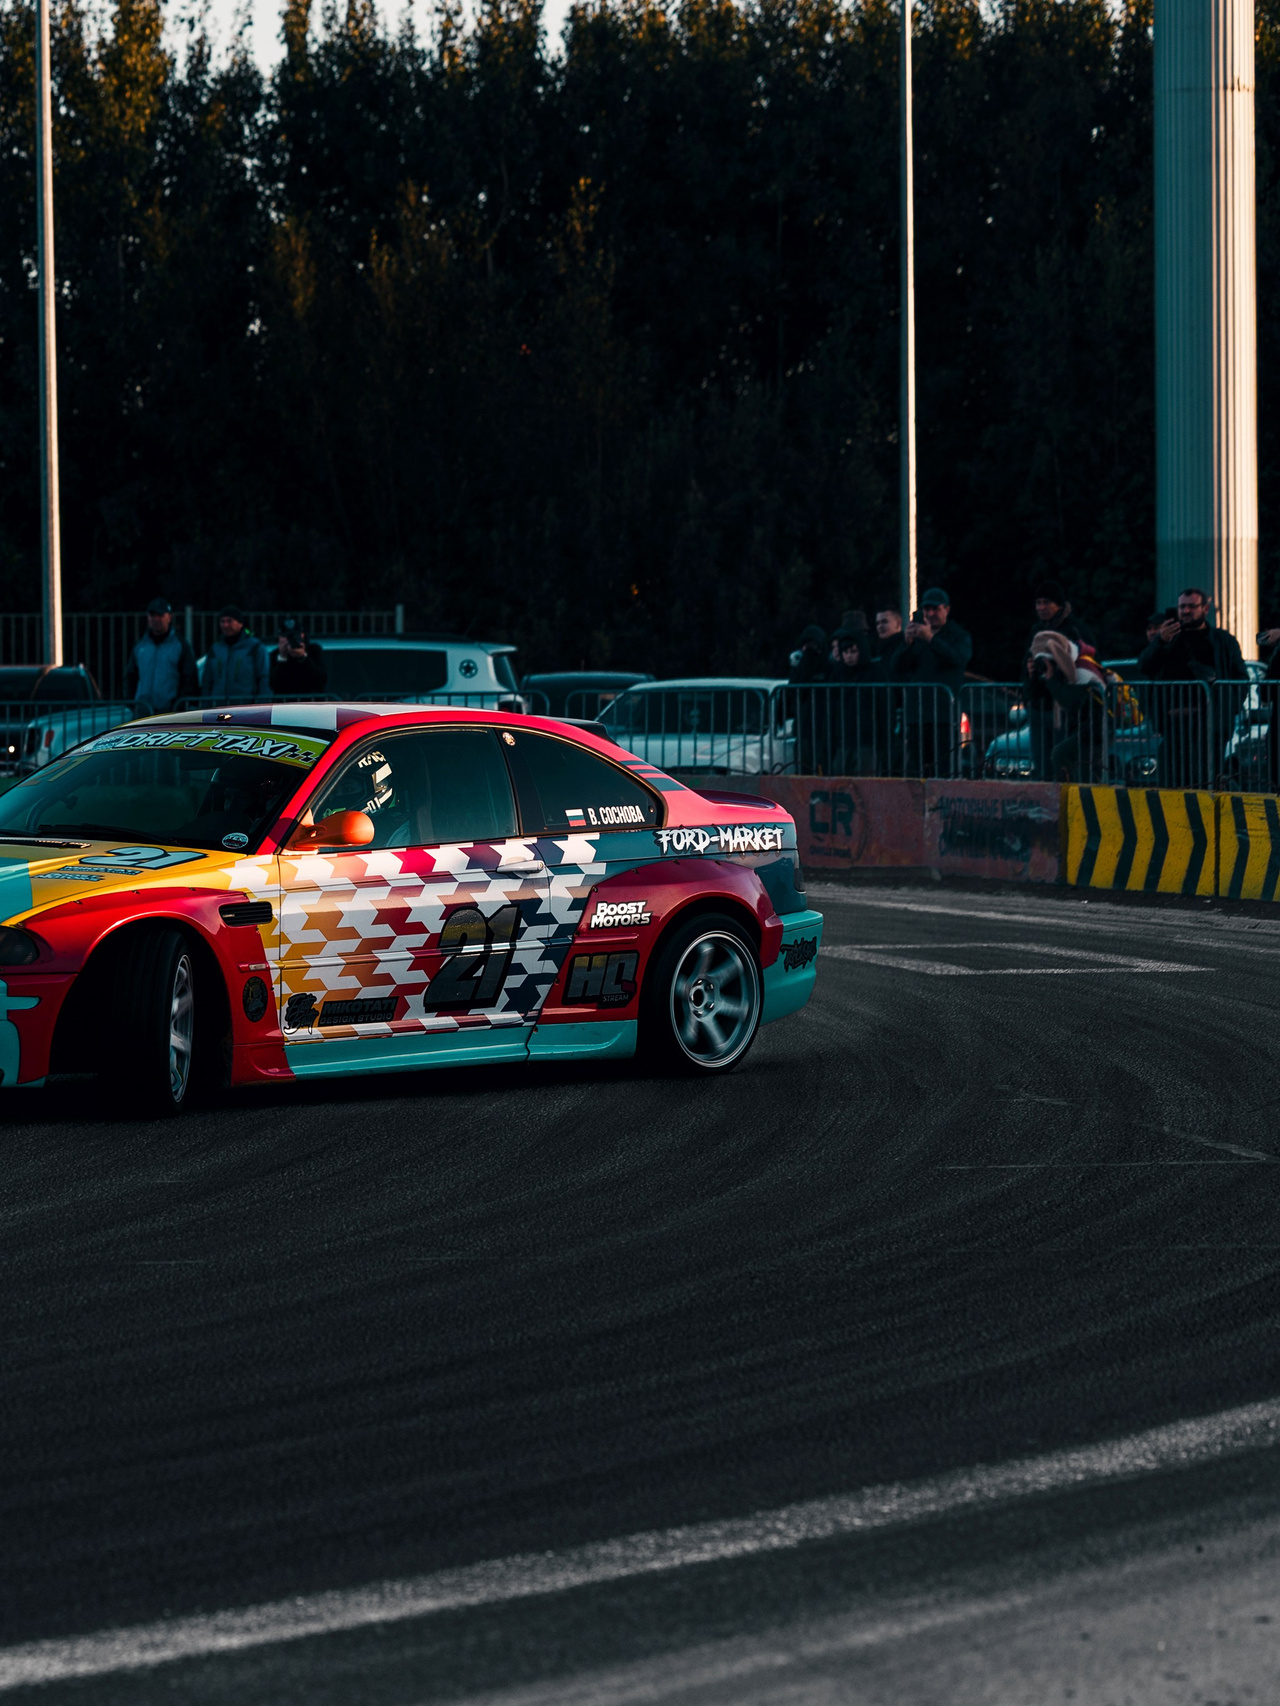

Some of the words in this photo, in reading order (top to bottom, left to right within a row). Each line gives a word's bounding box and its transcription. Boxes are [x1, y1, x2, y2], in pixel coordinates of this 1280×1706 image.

[119, 732, 218, 749] DRIFT
[217, 734, 293, 759] TAXI
[657, 826, 785, 853] FORD-MARKET
[79, 846, 208, 870] 21
[596, 901, 647, 916] BOOST
[590, 912, 652, 928] MOTORS
[423, 904, 520, 1013] 21
[322, 998, 397, 1015] MIKOTATI
[602, 994, 629, 1003] STREAM
[319, 1015, 355, 1025] DESIGN
[357, 1012, 393, 1022] STUDIO
